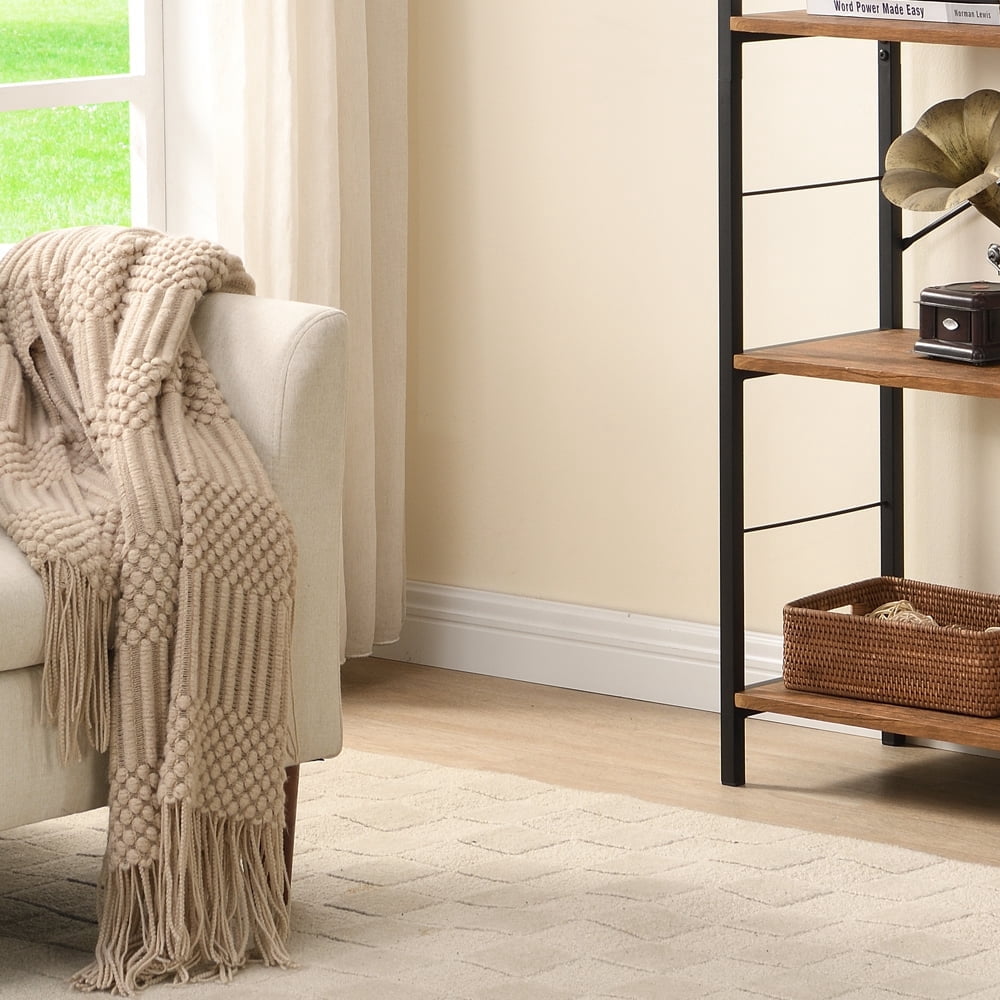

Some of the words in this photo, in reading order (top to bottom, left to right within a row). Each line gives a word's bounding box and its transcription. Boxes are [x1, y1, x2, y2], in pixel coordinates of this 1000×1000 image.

[833, 0, 854, 13] Word
[856, 2, 880, 16] Power
[882, 3, 904, 16] Made
[906, 4, 925, 18] Easy
[954, 9, 975, 18] Norman
[976, 10, 992, 19] Lewis
